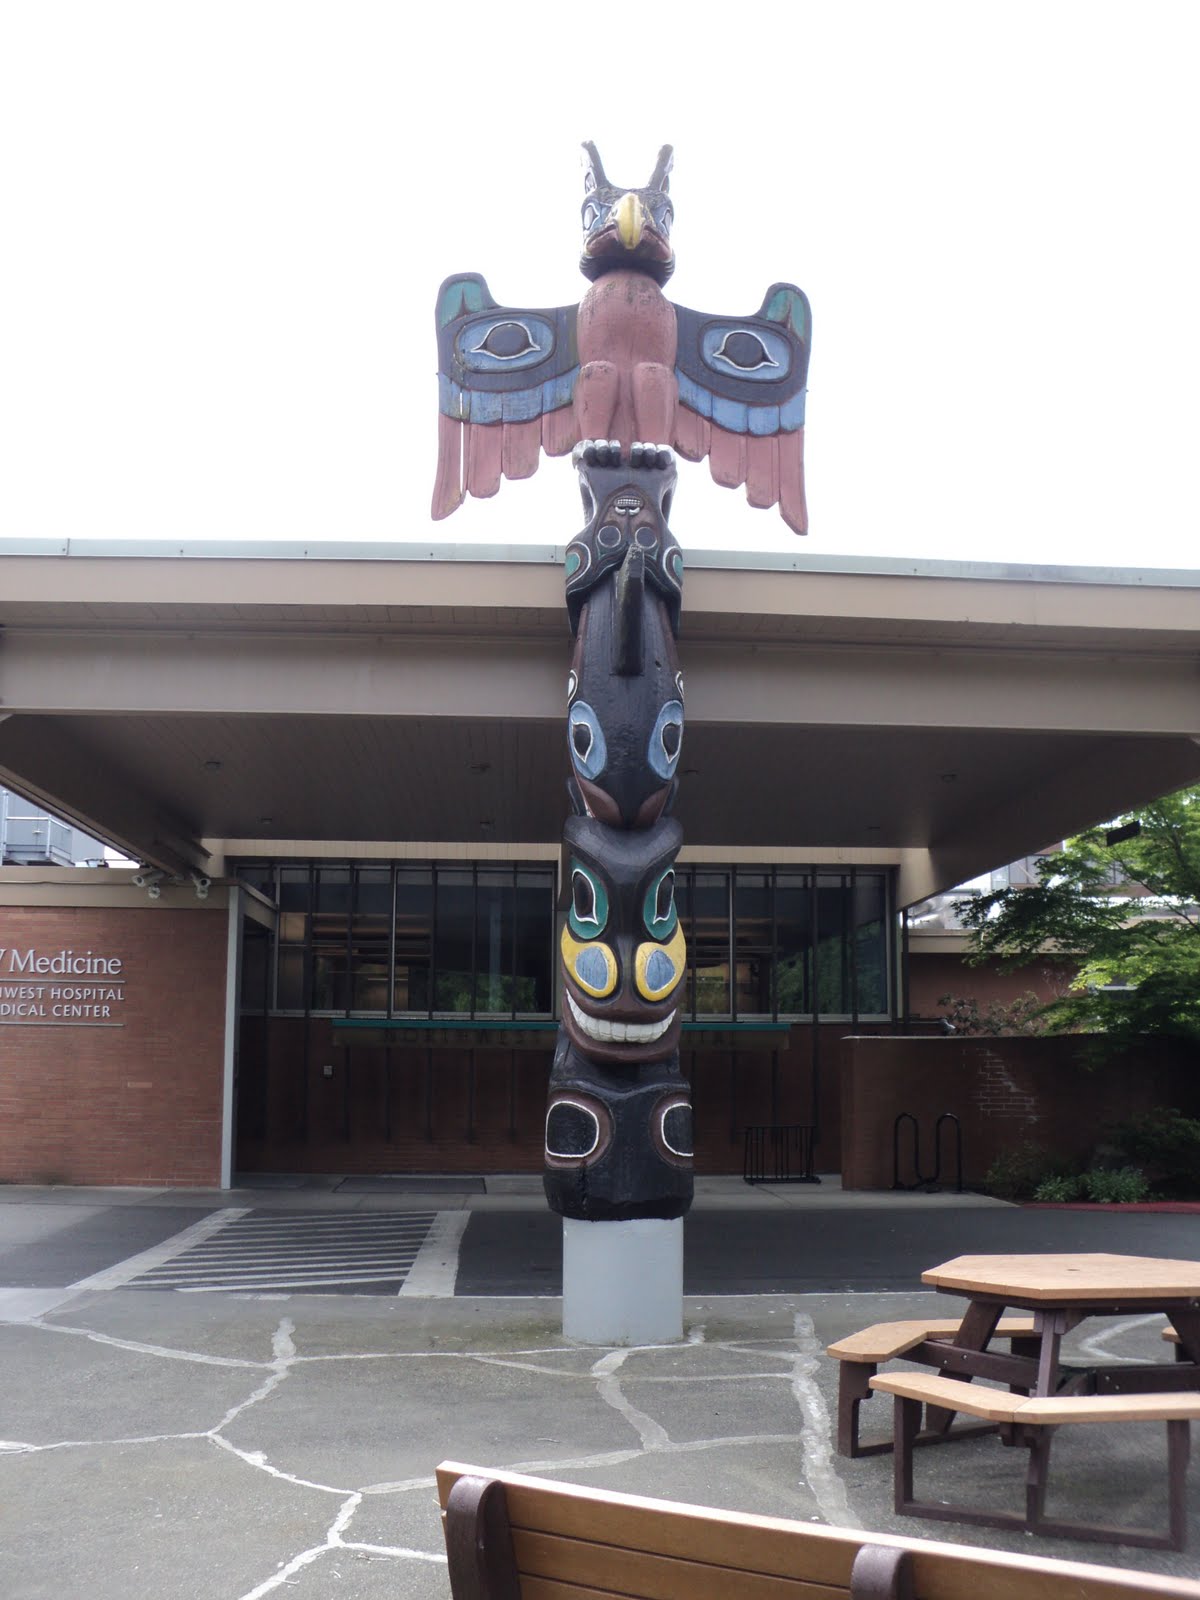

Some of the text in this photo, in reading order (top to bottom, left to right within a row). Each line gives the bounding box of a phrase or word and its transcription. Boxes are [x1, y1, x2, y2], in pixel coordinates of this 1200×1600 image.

[9, 949, 122, 975] Medicine
[0, 986, 125, 1000] WEST HOSPITAL
[52, 1004, 111, 1017] CENTER
